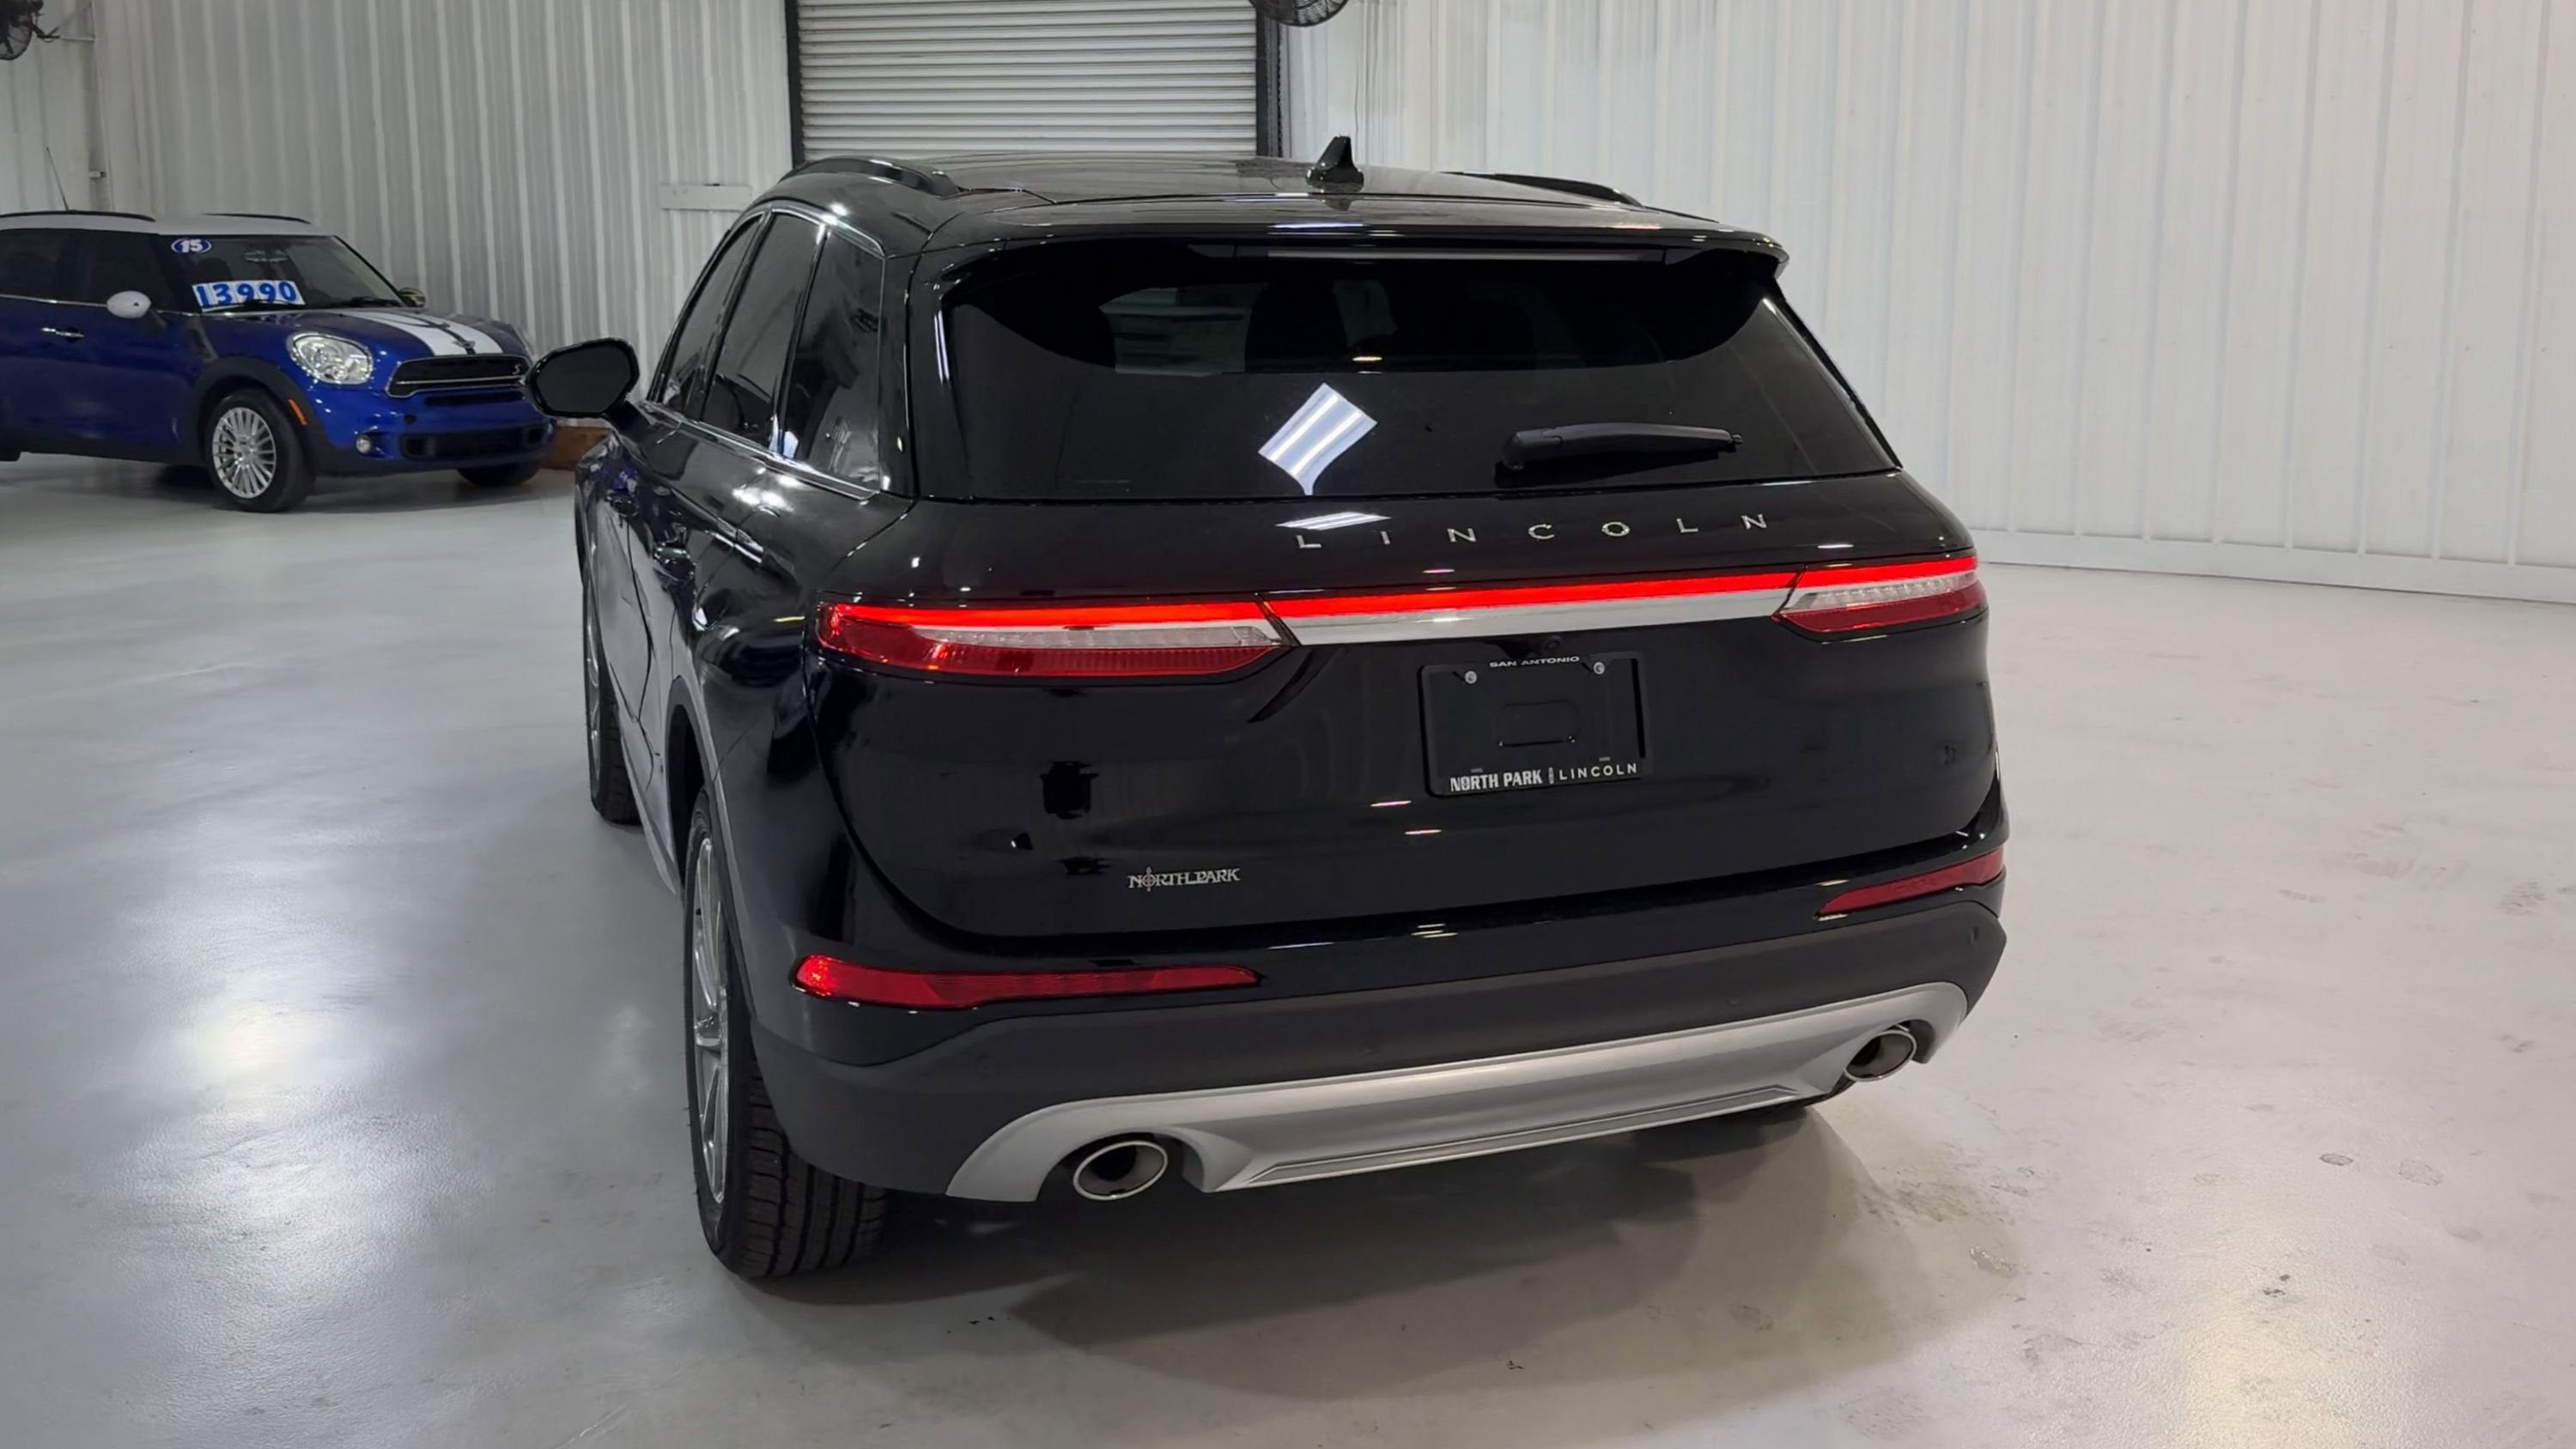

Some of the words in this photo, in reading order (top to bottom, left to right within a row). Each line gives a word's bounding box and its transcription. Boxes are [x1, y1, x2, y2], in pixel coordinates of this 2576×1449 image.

[179, 239, 204, 253] 15
[196, 281, 297, 309] 13990
[1295, 513, 1768, 549] LINCOLN
[1521, 656, 1581, 666] ANTONIO
[1450, 773, 1499, 792] NORTH
[1504, 769, 1544, 788] PARK
[1558, 763, 1637, 781] LINCOLN
